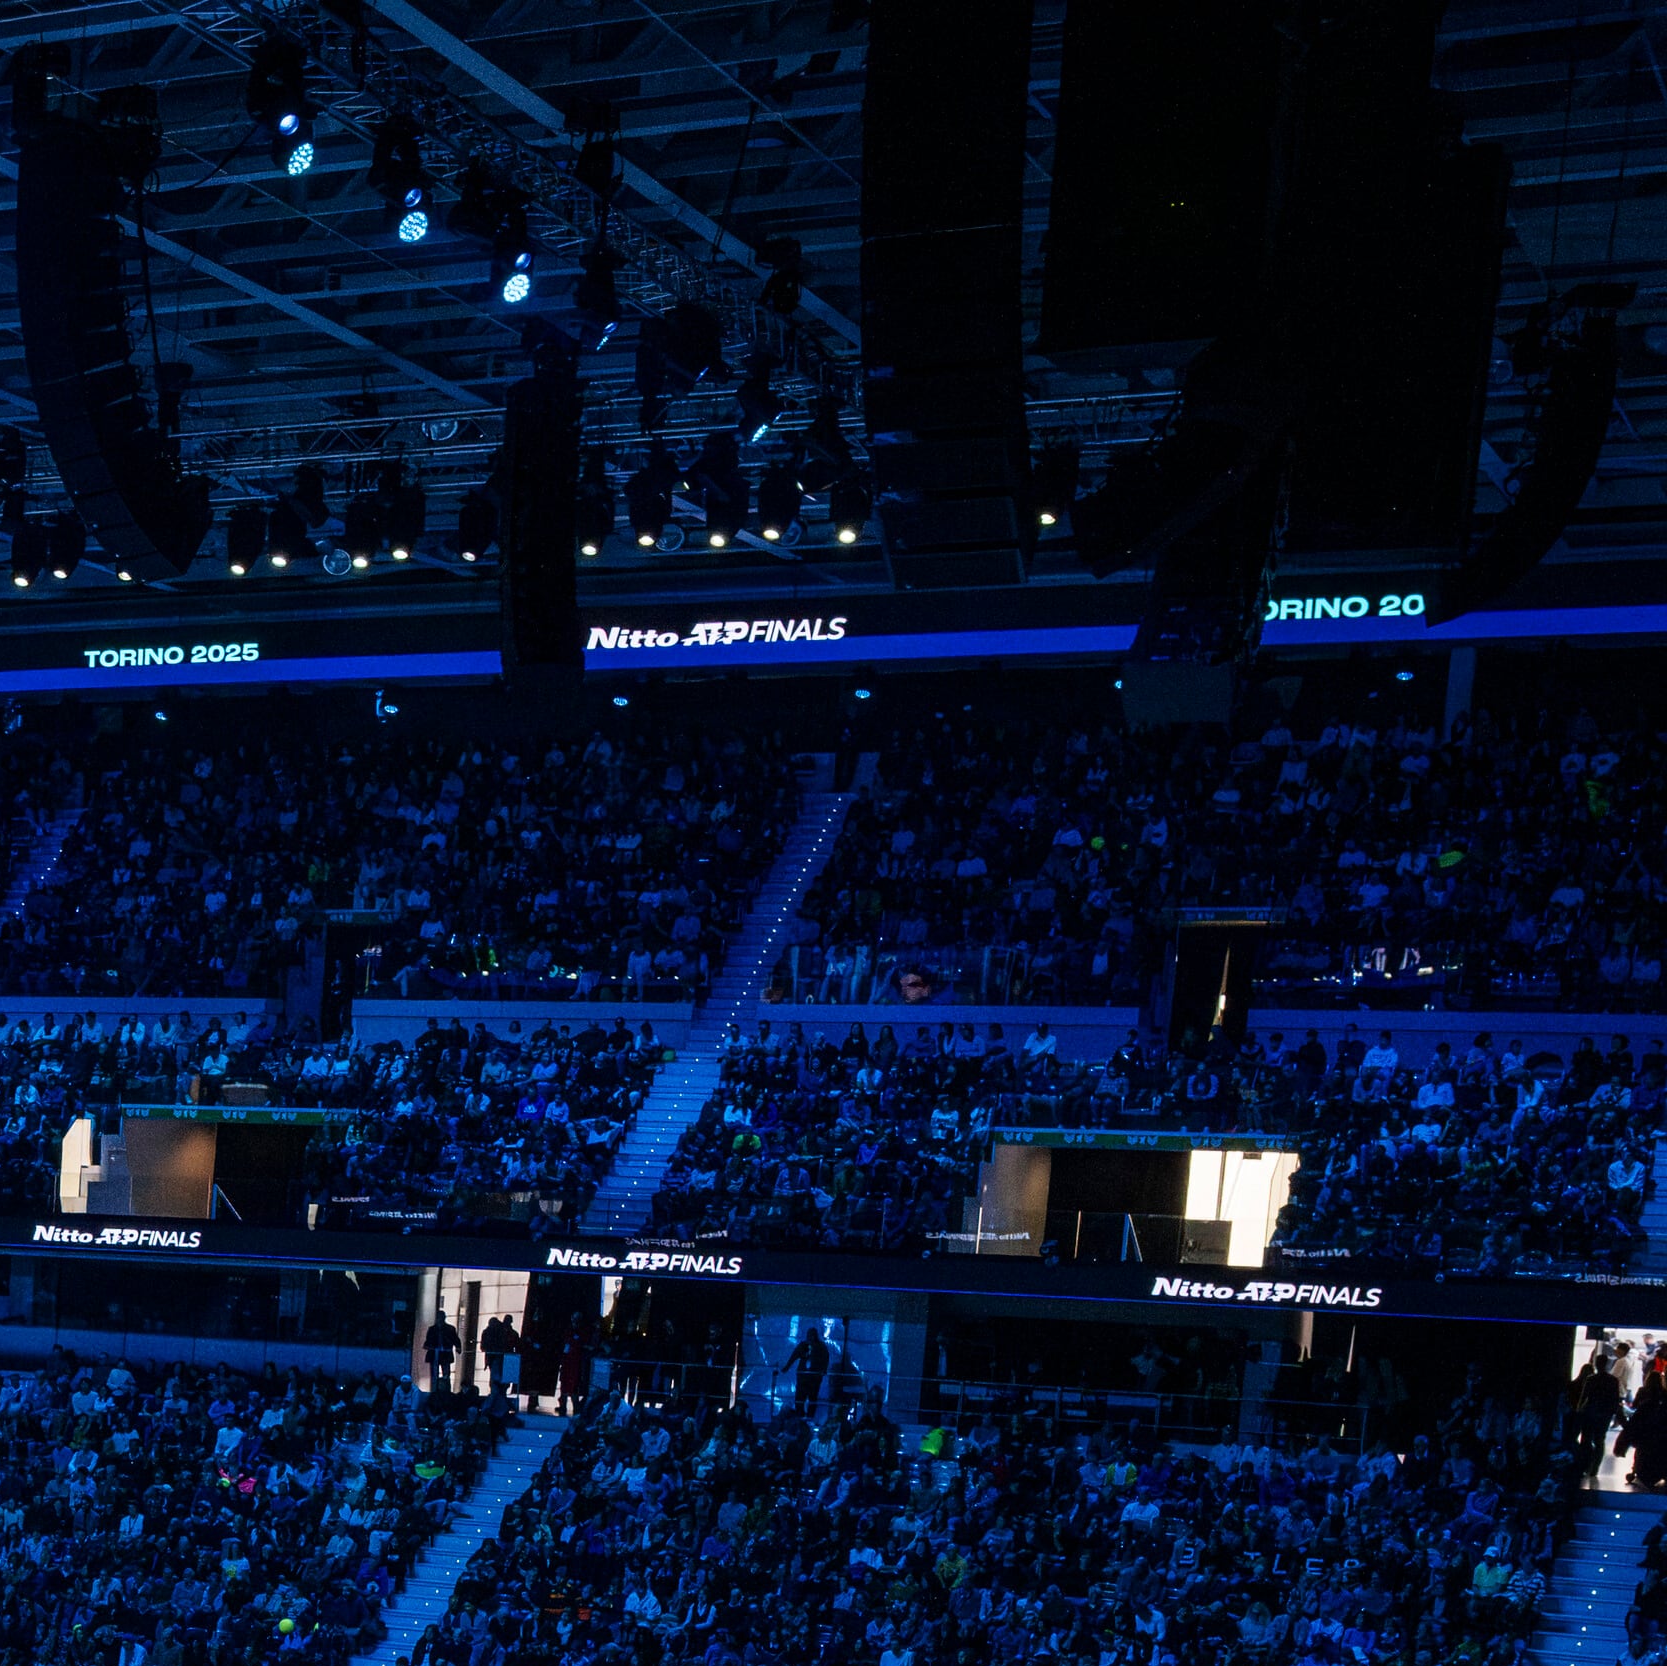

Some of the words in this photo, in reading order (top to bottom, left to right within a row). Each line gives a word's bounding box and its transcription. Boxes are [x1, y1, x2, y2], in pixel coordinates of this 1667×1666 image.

[586, 626, 680, 650] Nitto
[748, 616, 847, 642] FINALS
[84, 646, 184, 668] TORINO
[190, 643, 259, 665] 2025
[546, 1247, 618, 1269] Nitto
[672, 1254, 742, 1276] FINALS
[1151, 1276, 1237, 1300] Nitto
[1299, 1284, 1382, 1307] FINALS
